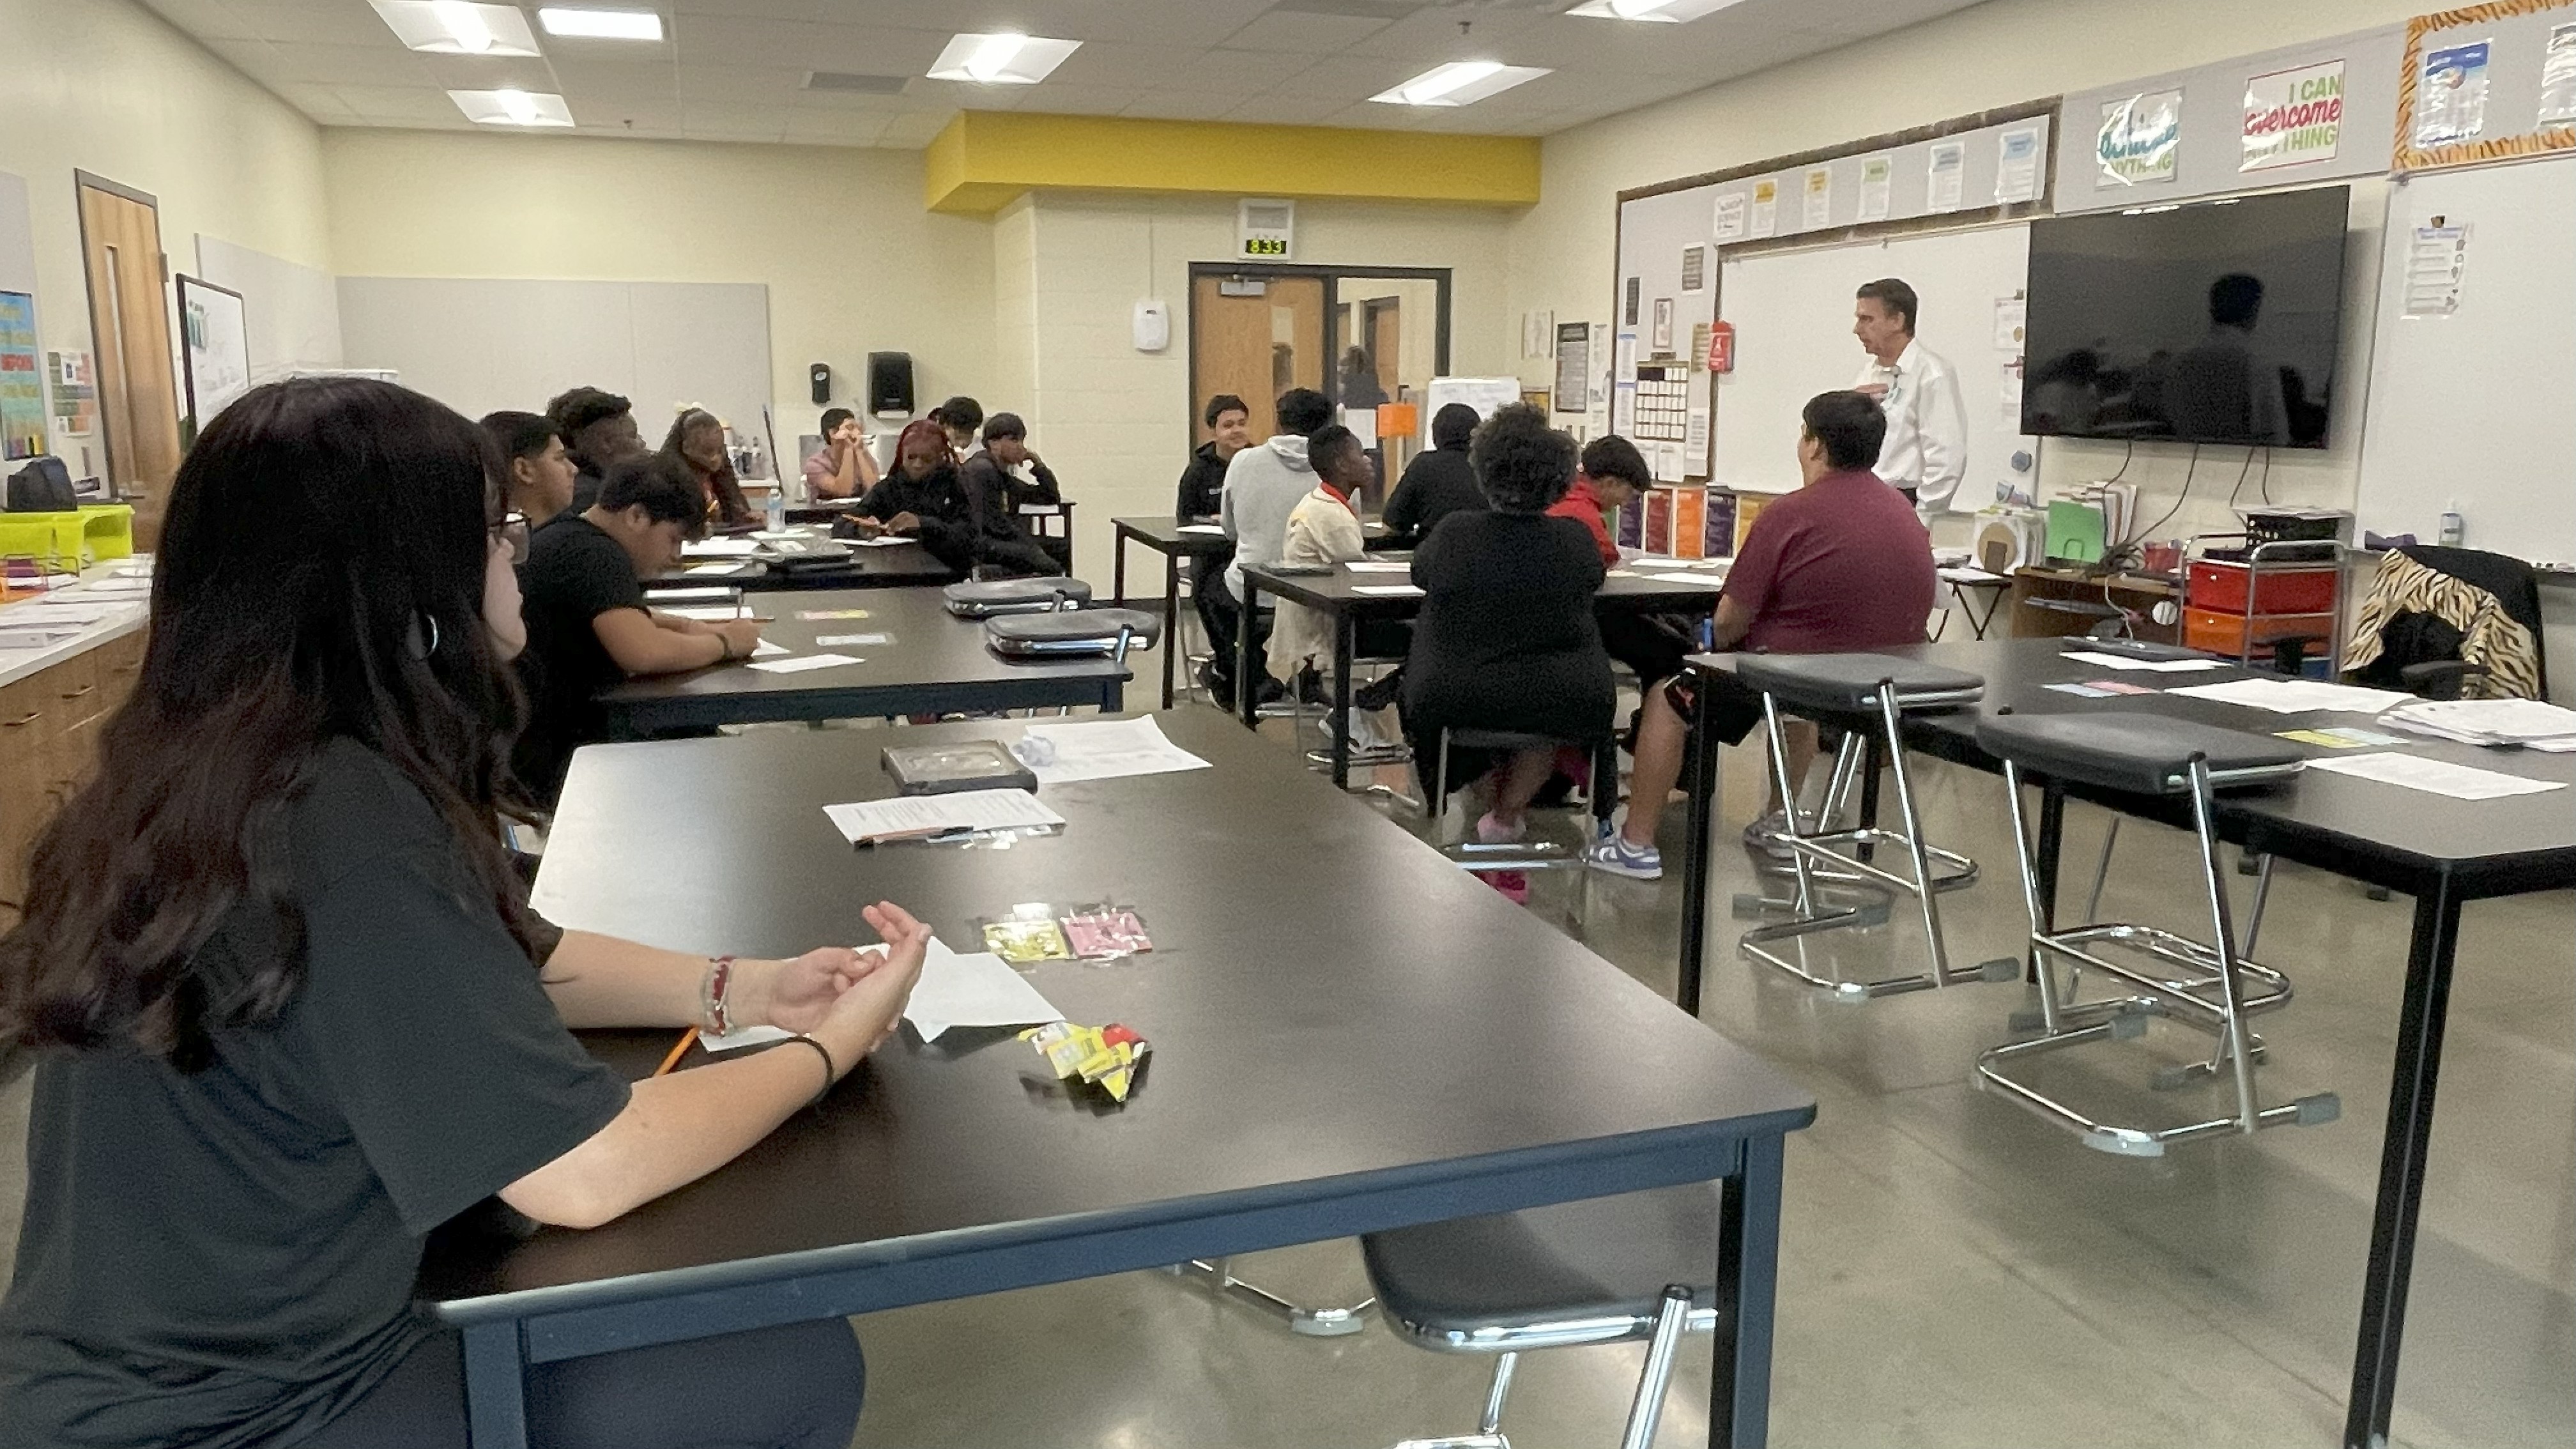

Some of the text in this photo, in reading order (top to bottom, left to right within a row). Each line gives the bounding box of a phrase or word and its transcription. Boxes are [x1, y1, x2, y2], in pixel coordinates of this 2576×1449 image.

[2289, 74, 2342, 103] I CAN
[2244, 125, 2338, 159] THING
